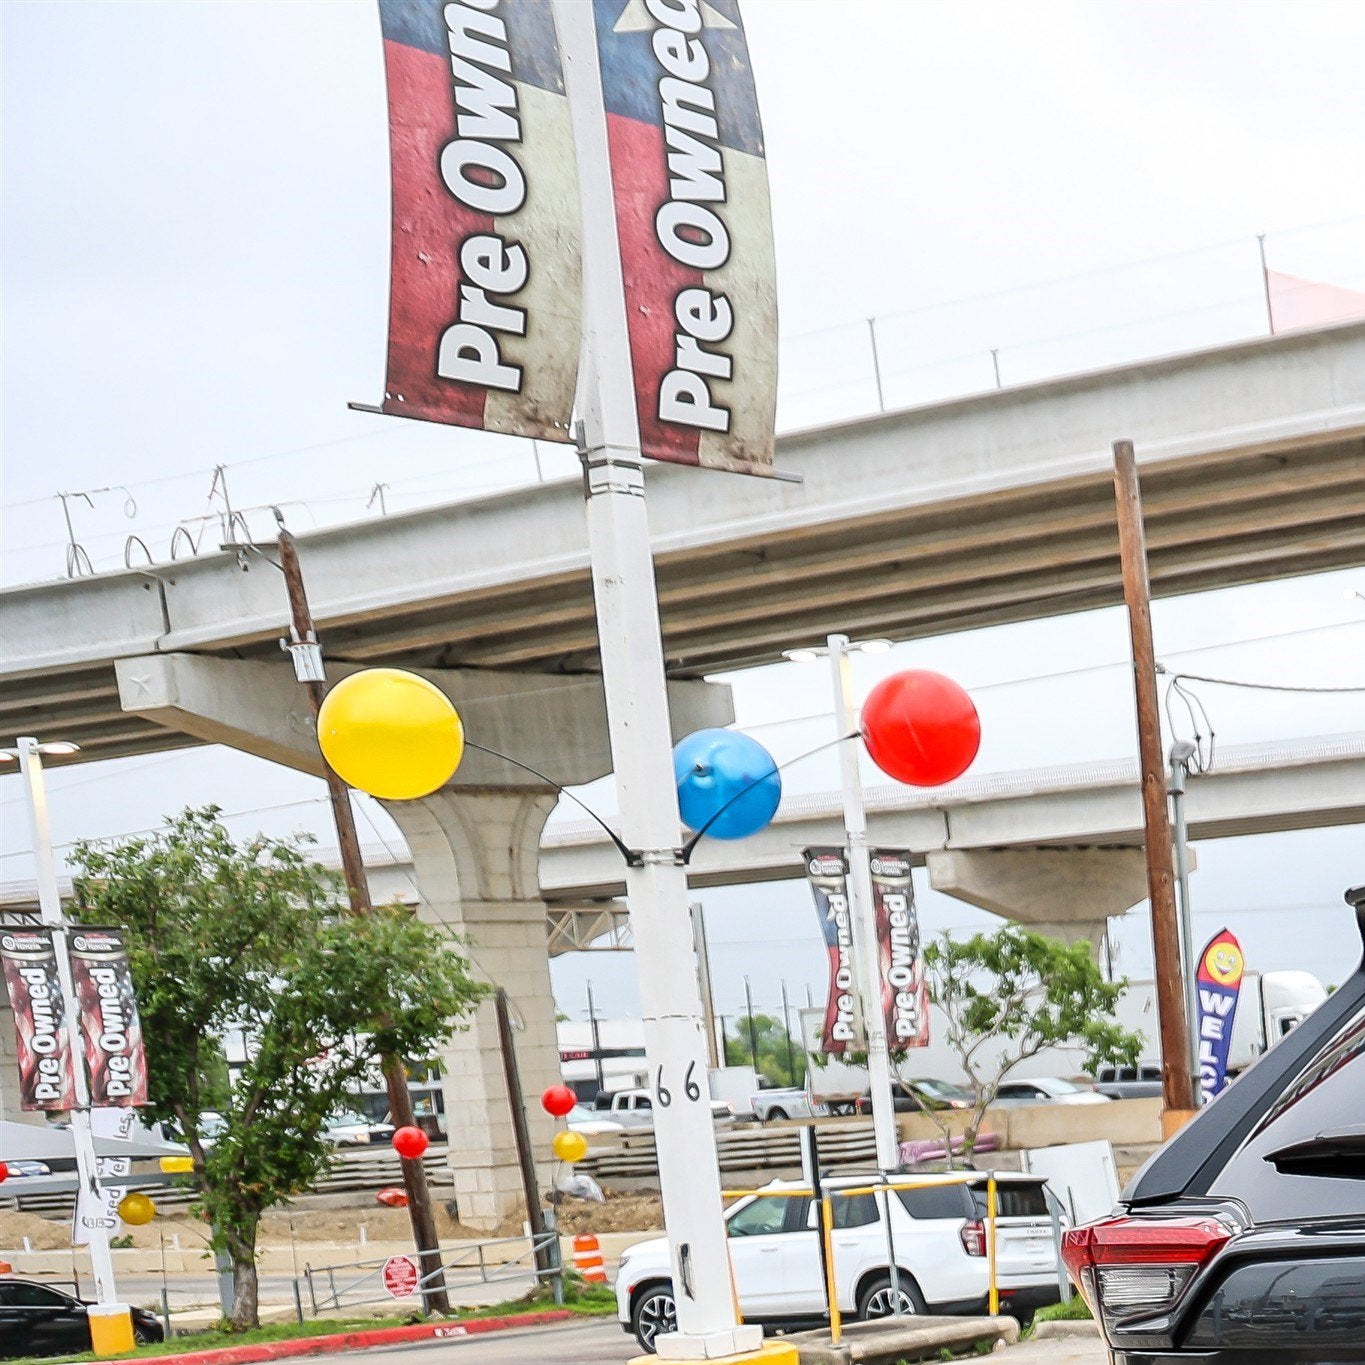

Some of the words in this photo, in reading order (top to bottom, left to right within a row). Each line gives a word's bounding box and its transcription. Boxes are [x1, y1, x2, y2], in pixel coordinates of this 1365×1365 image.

[440, 0, 528, 214] Own
[437, 234, 530, 392] Pre
[658, 287, 735, 432] Pre
[828, 893, 853, 990] Owned
[883, 893, 914, 988] Owned
[19, 967, 58, 1054] Owned
[89, 967, 128, 1052] Owned
[832, 993, 854, 1041] Pre
[895, 991, 918, 1038] Pre
[35, 1057, 61, 1100] Pre
[106, 1054, 132, 1097] Pre
[656, 1064, 671, 1107] 6
[684, 1060, 700, 1102] 6
